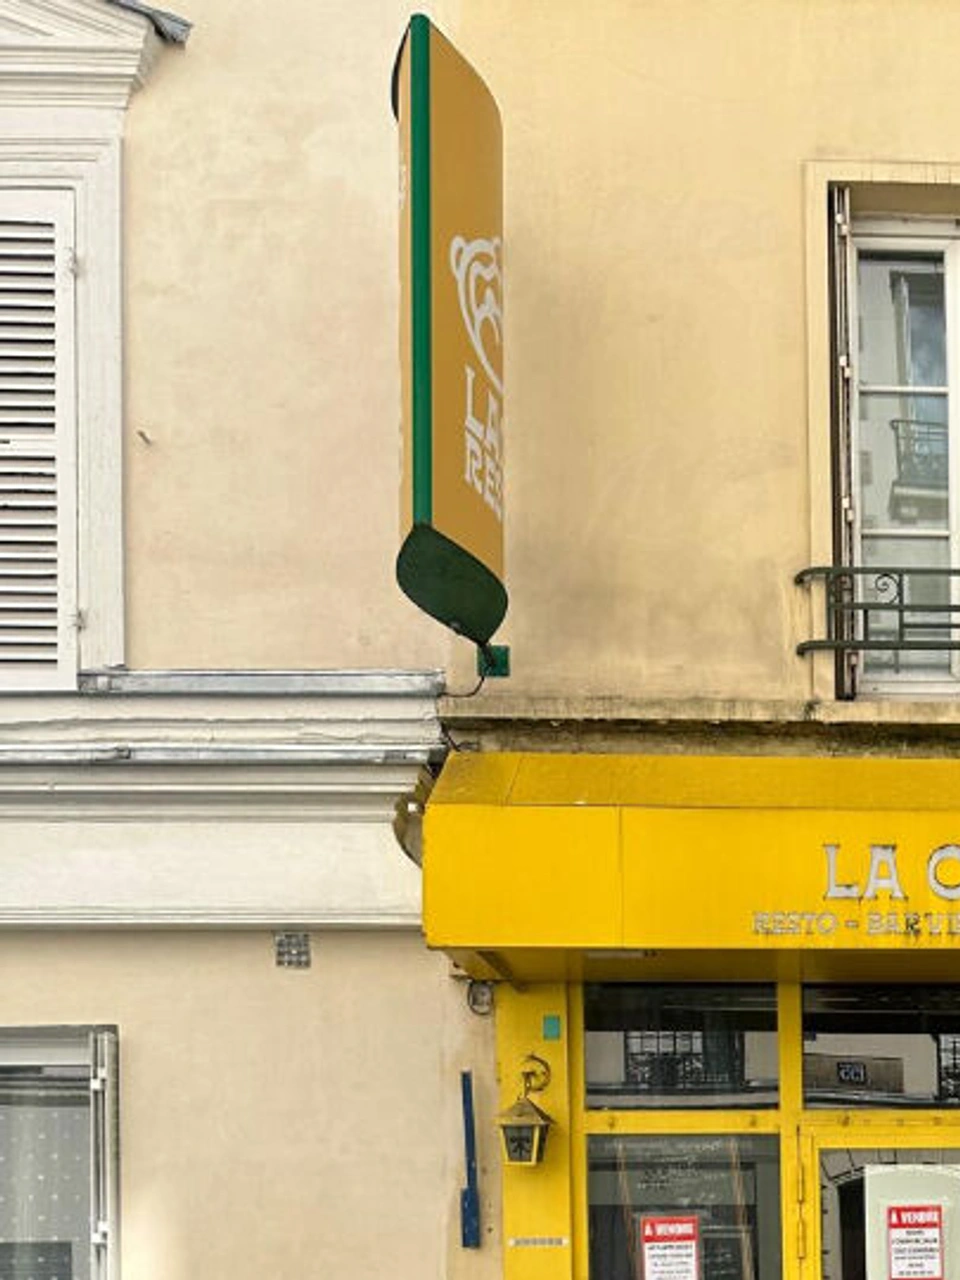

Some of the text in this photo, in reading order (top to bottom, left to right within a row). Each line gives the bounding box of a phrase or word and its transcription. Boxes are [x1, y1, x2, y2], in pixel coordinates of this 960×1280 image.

[822, 843, 909, 901] LA
[754, 911, 838, 936] RESTO
[868, 911, 921, 936] BAR
